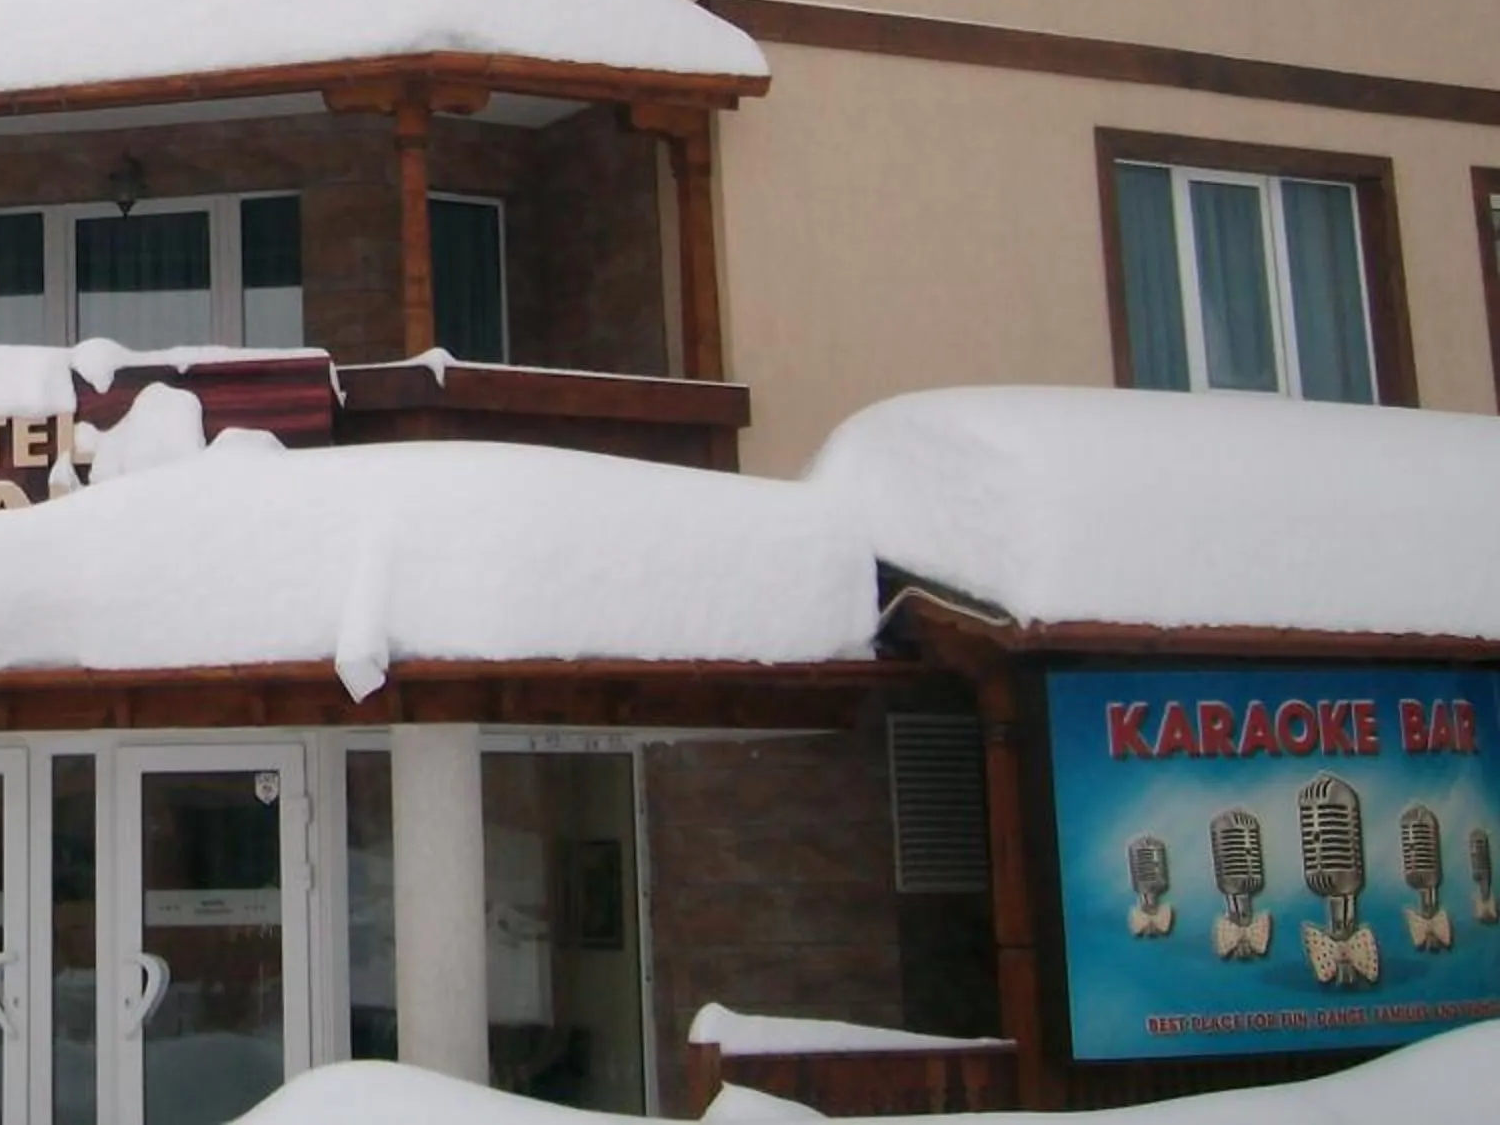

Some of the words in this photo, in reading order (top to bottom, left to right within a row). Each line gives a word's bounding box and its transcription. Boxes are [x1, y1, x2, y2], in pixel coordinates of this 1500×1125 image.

[1106, 699, 1380, 759] KARAOKE
[1398, 698, 1481, 756] BAR
[1146, 1013, 1187, 1035] BEST
[1245, 1009, 1275, 1031] FOR
